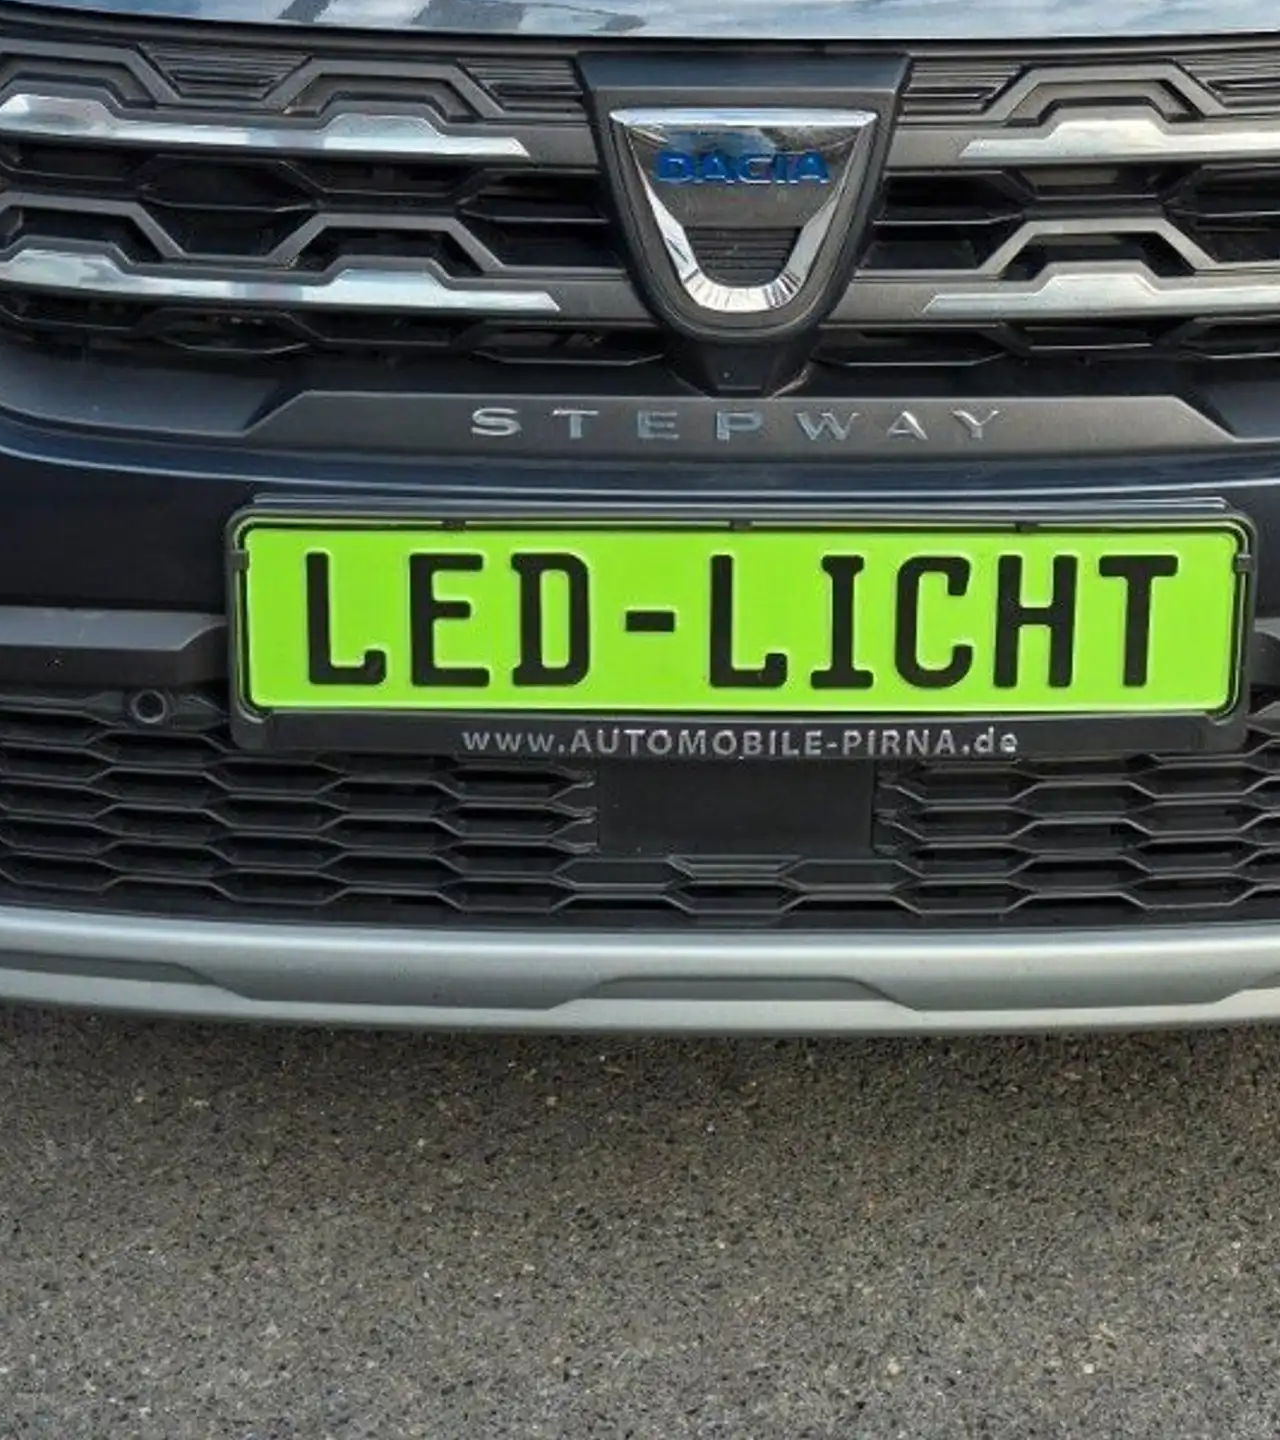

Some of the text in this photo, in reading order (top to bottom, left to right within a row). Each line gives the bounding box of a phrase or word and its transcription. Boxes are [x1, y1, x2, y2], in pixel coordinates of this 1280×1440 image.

[654, 150, 829, 184] DACIA
[470, 407, 1000, 441] STEPWAY
[305, 551, 1179, 692] LED-LICHT
[461, 726, 1019, 757] www.AUTOMOBILE-PIRNA.de
